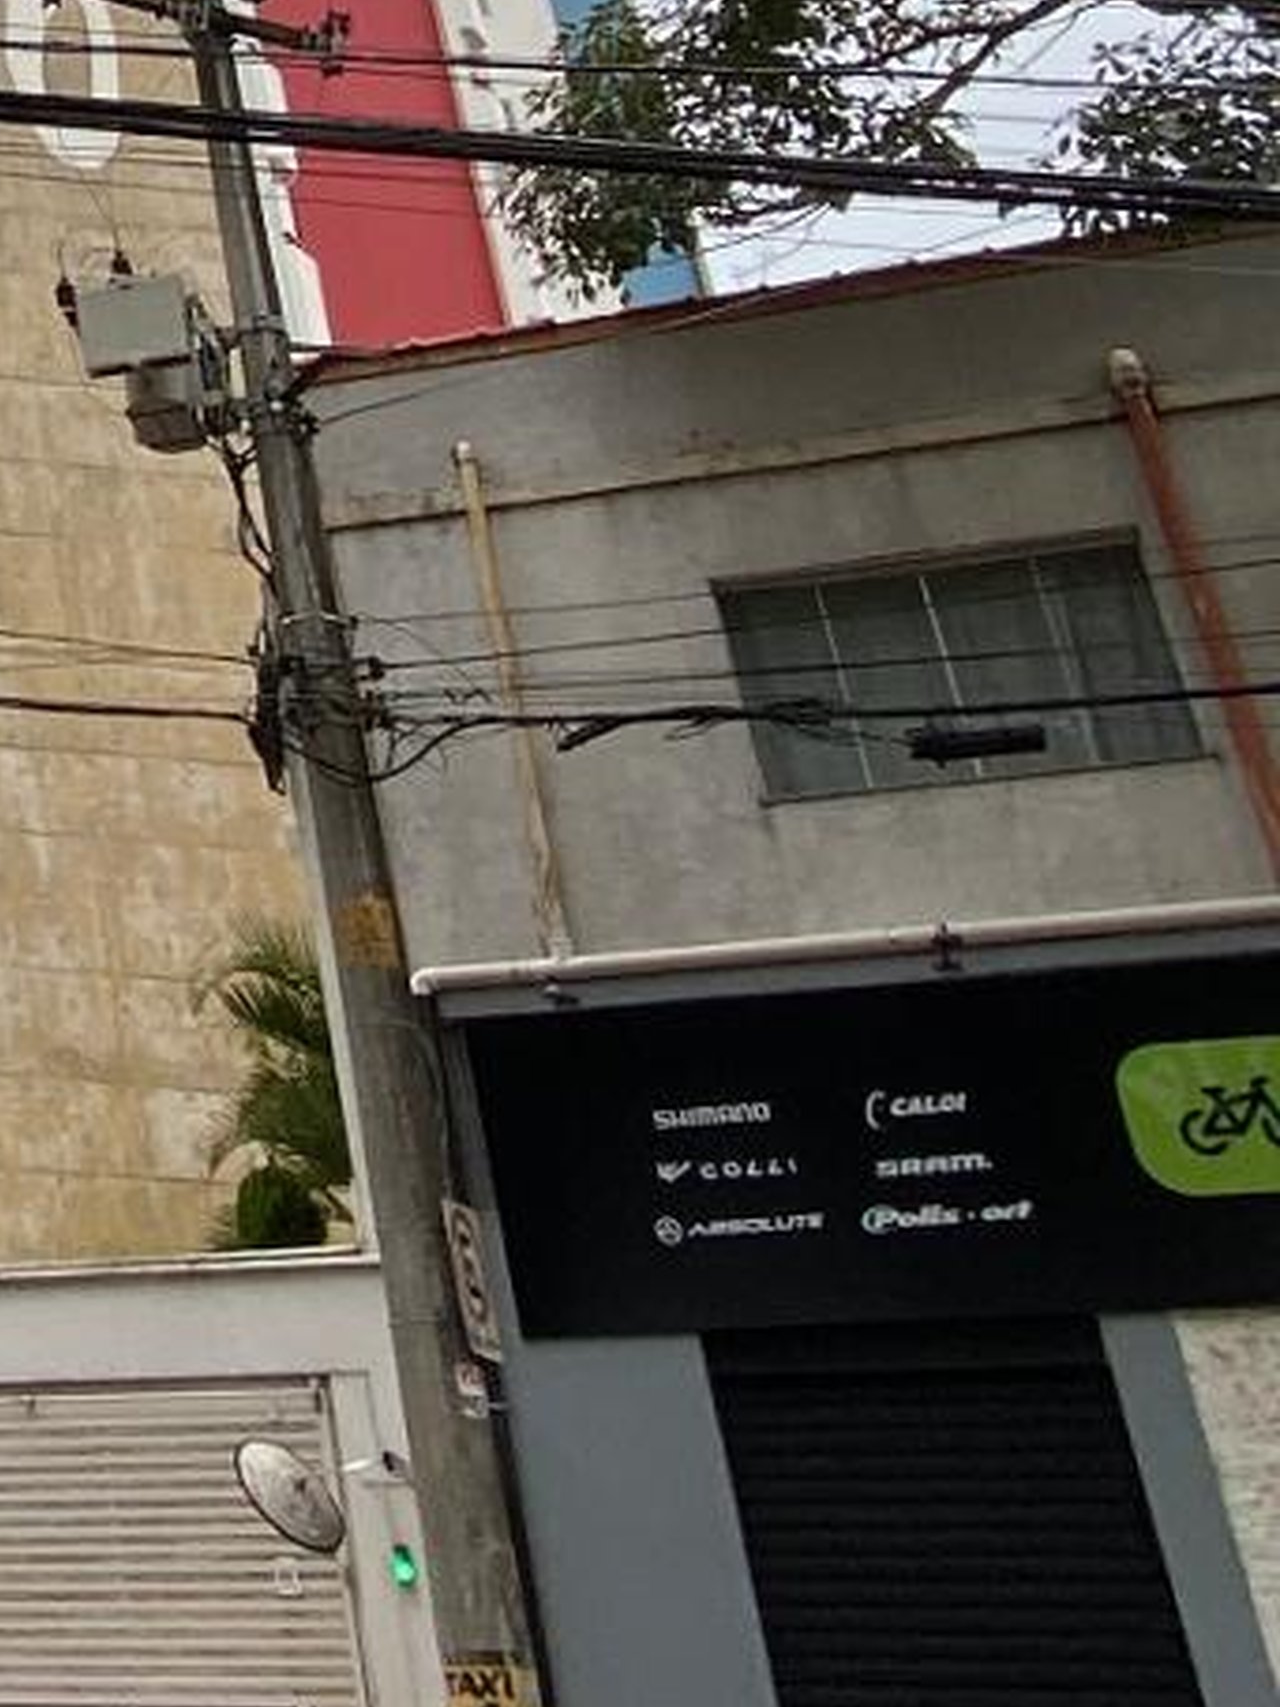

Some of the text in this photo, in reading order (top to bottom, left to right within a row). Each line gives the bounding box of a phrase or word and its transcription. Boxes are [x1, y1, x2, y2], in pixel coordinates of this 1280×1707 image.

[651, 1101, 772, 1131] SHIMANO
[687, 1212, 825, 1239] ABSOLUTE
[445, 1669, 516, 1700] TAXI
